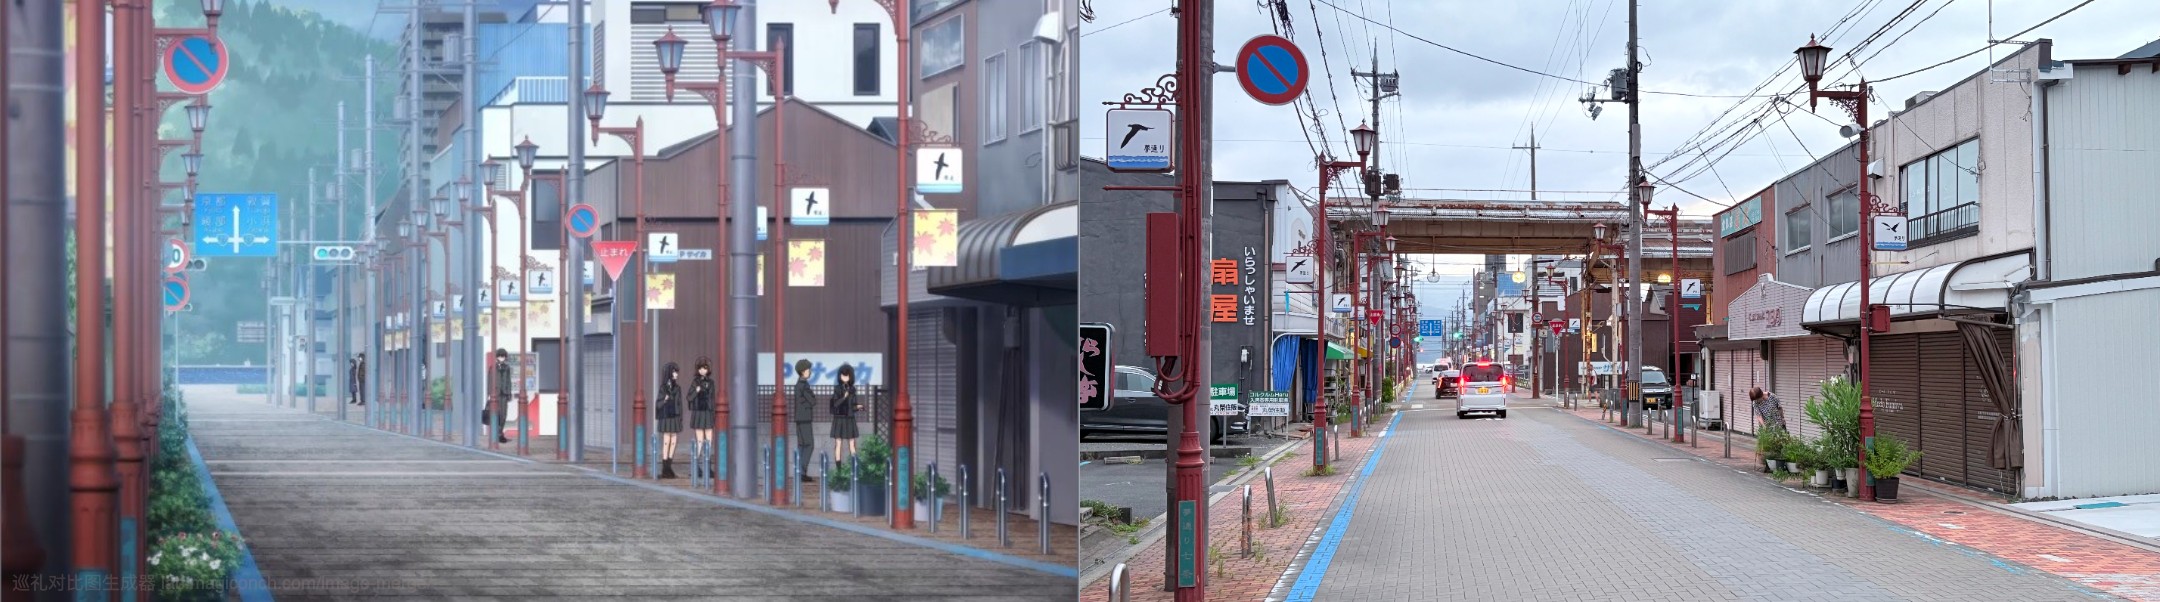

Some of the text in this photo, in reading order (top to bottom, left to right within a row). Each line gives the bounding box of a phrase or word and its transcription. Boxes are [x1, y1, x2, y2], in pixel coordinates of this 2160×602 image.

[600, 247, 629, 257] 止まれ
[1210, 257, 1238, 322] 扇屋
[1243, 246, 1256, 326] いらっしゃいませ
